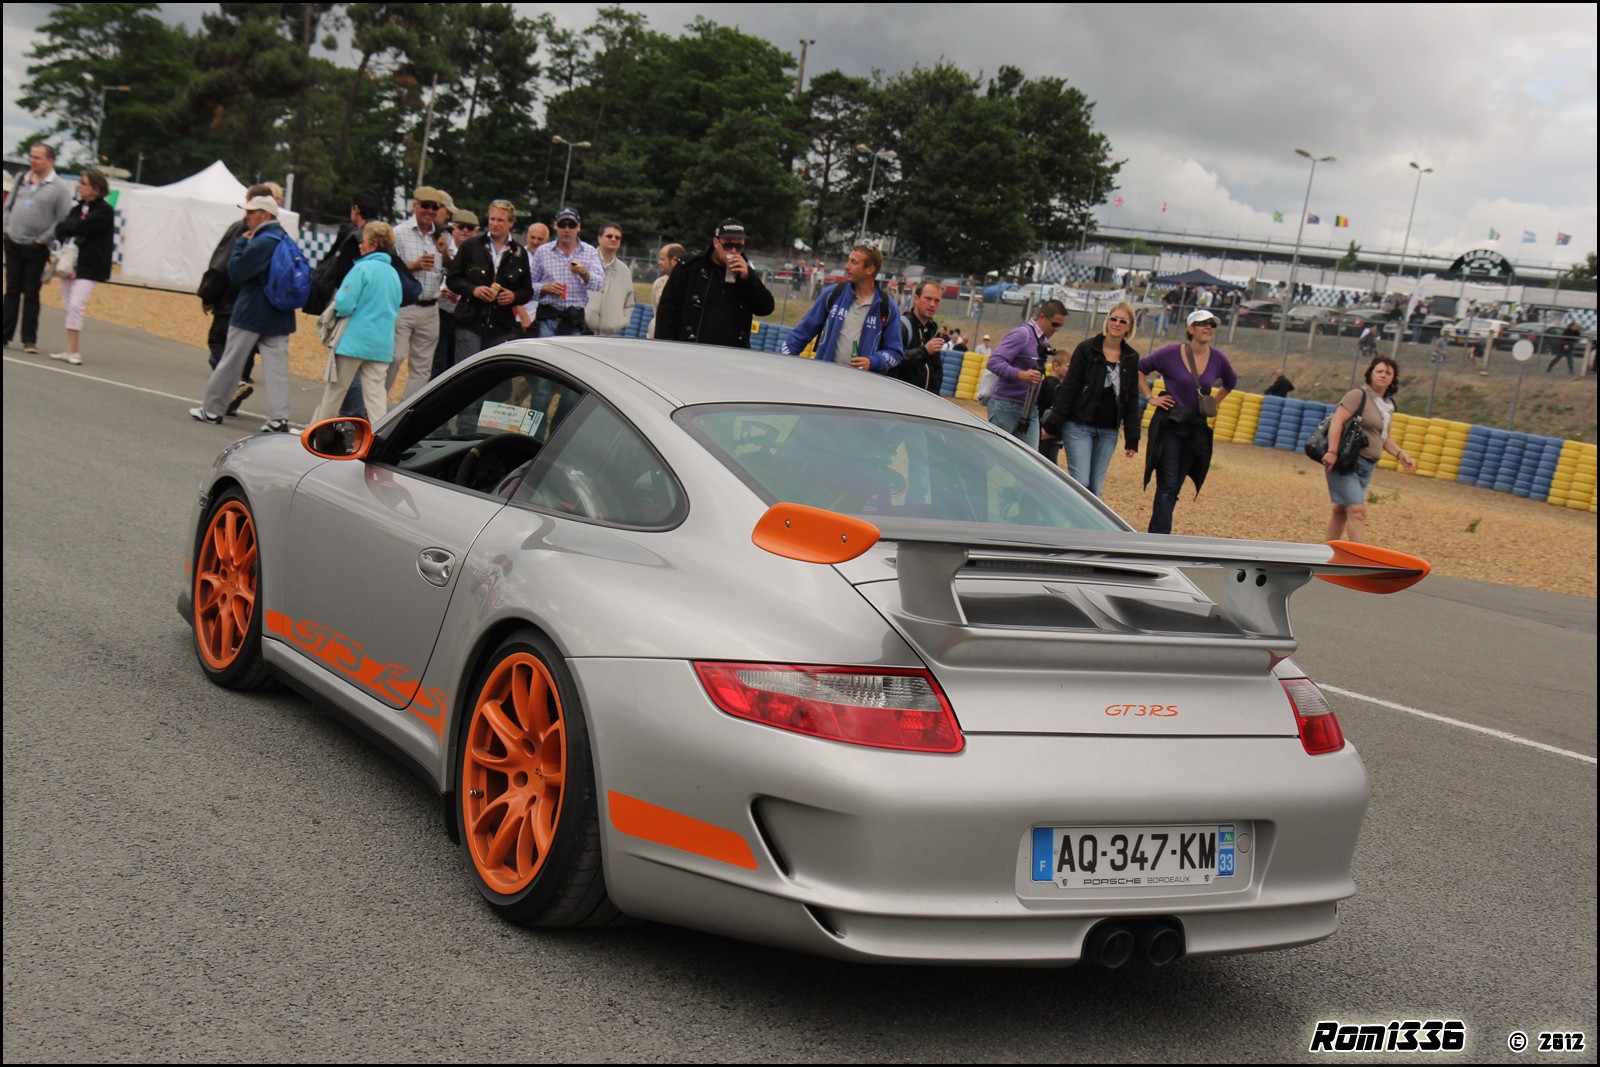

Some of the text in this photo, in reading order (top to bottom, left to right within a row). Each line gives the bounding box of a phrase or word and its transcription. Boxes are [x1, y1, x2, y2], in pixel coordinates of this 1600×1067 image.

[1104, 704, 1179, 717] GT3RS
[1039, 833, 1233, 874] F AQ-347-KM 33
[1147, 876, 1191, 884] BORDEAUX
